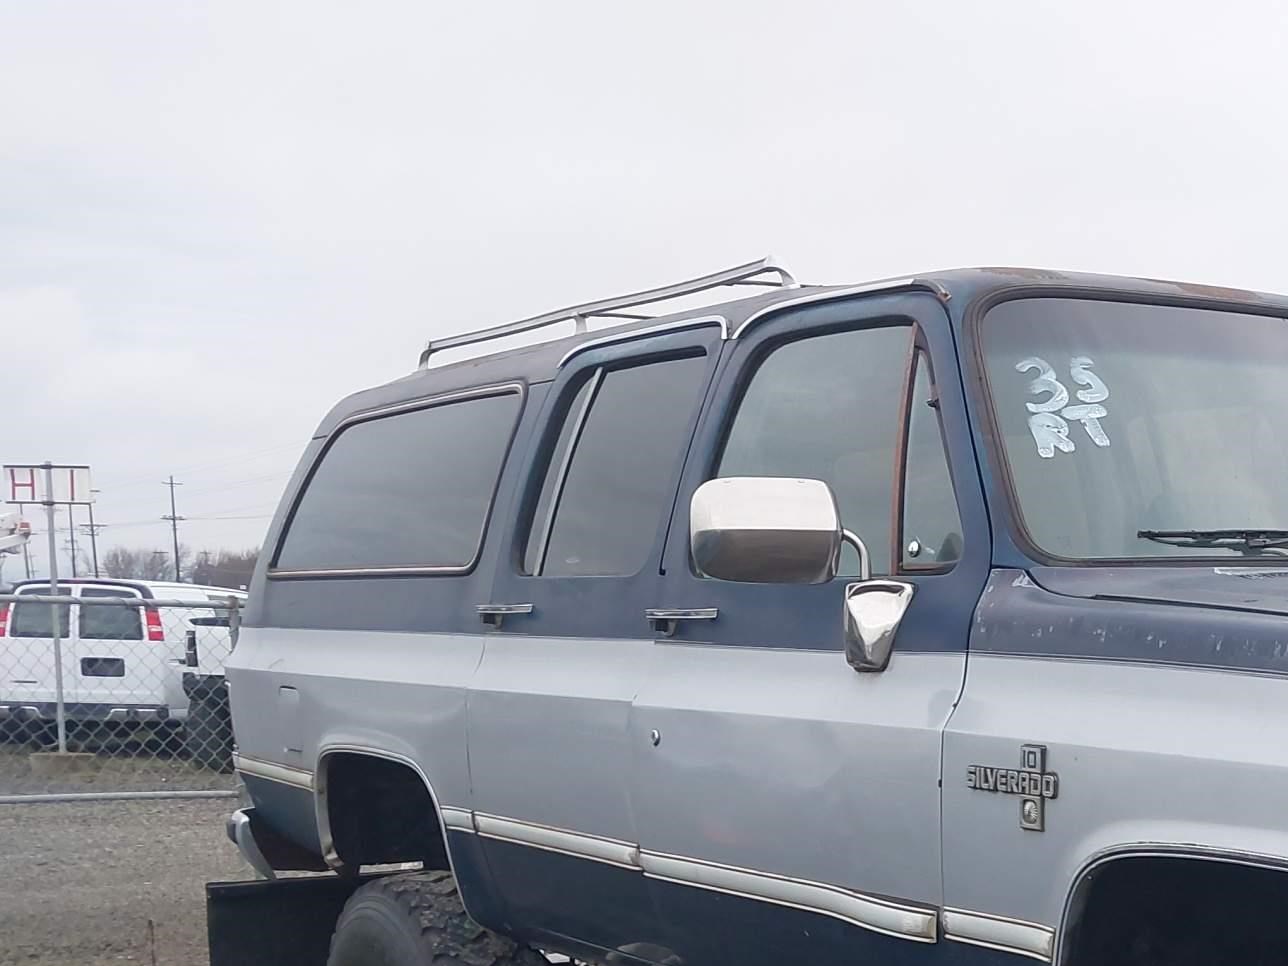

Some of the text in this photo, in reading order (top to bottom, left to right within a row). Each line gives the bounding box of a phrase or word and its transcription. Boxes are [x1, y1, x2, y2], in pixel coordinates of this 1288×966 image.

[1027, 403, 1111, 458] RT
[10, 468, 35, 500] H
[1022, 750, 1037, 769] 10
[966, 766, 1056, 798] SILVERADO
